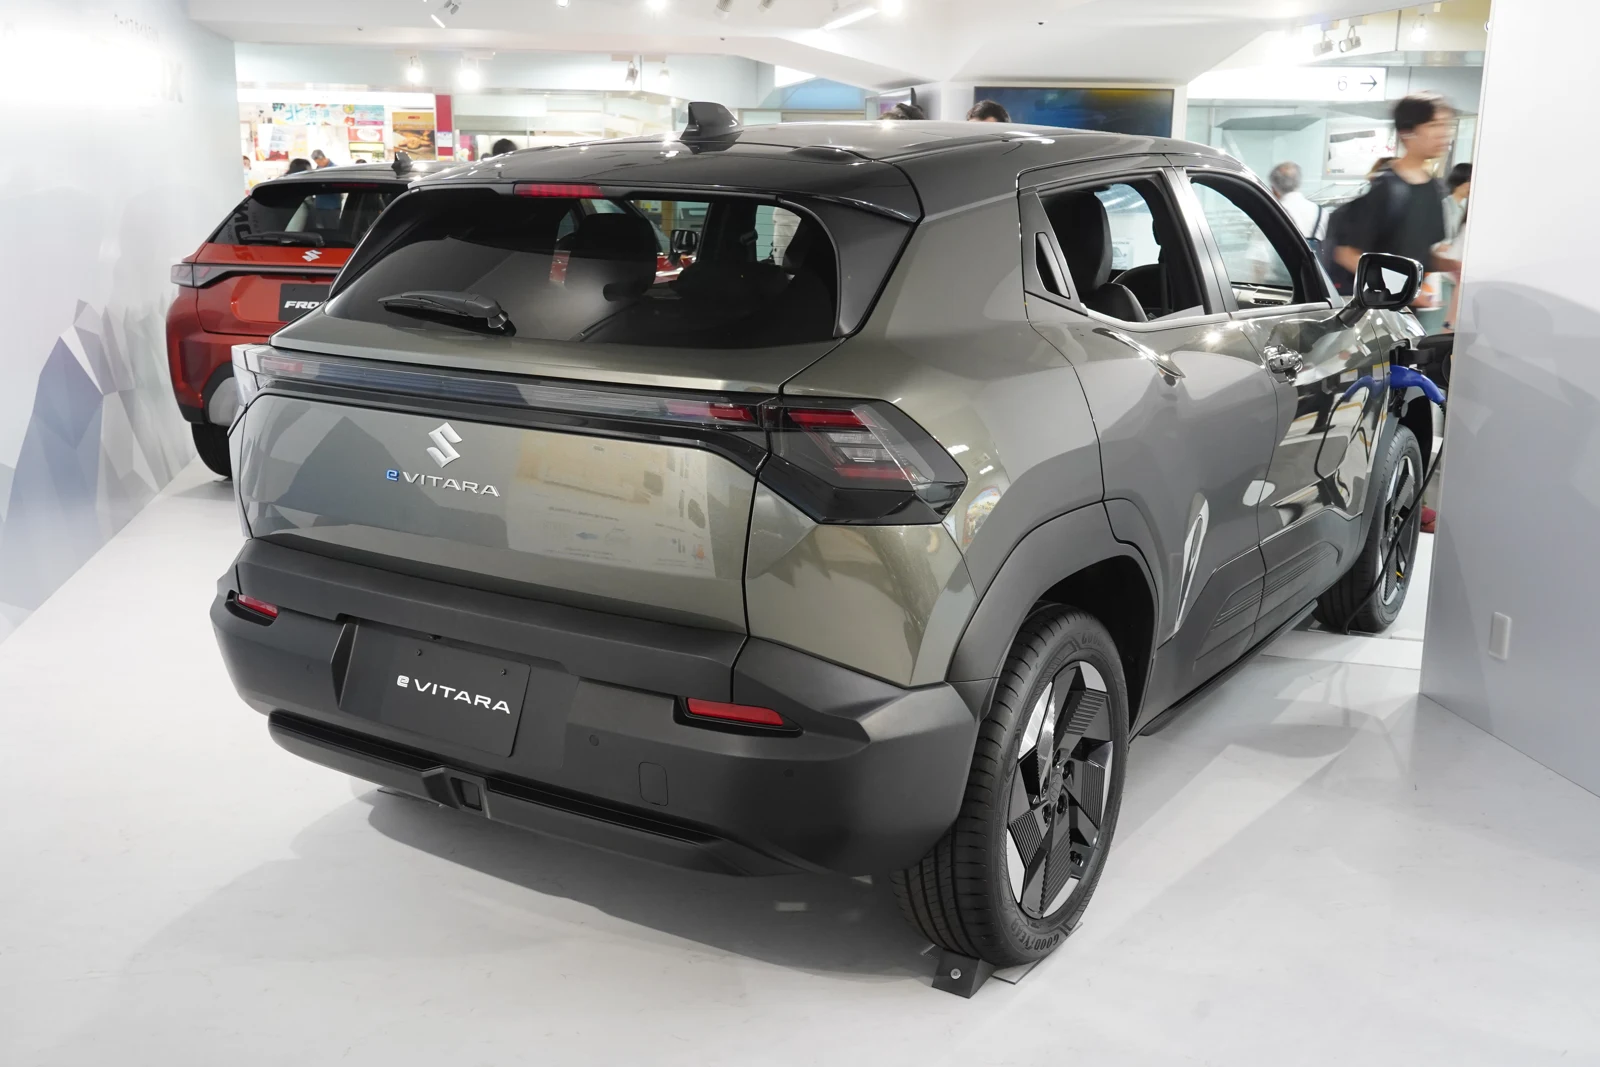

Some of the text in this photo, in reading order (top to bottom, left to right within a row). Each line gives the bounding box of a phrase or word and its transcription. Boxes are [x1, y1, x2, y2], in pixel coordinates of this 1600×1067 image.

[284, 300, 324, 309] FRO
[402, 471, 501, 498] VITARA
[414, 678, 511, 715] VITARA
